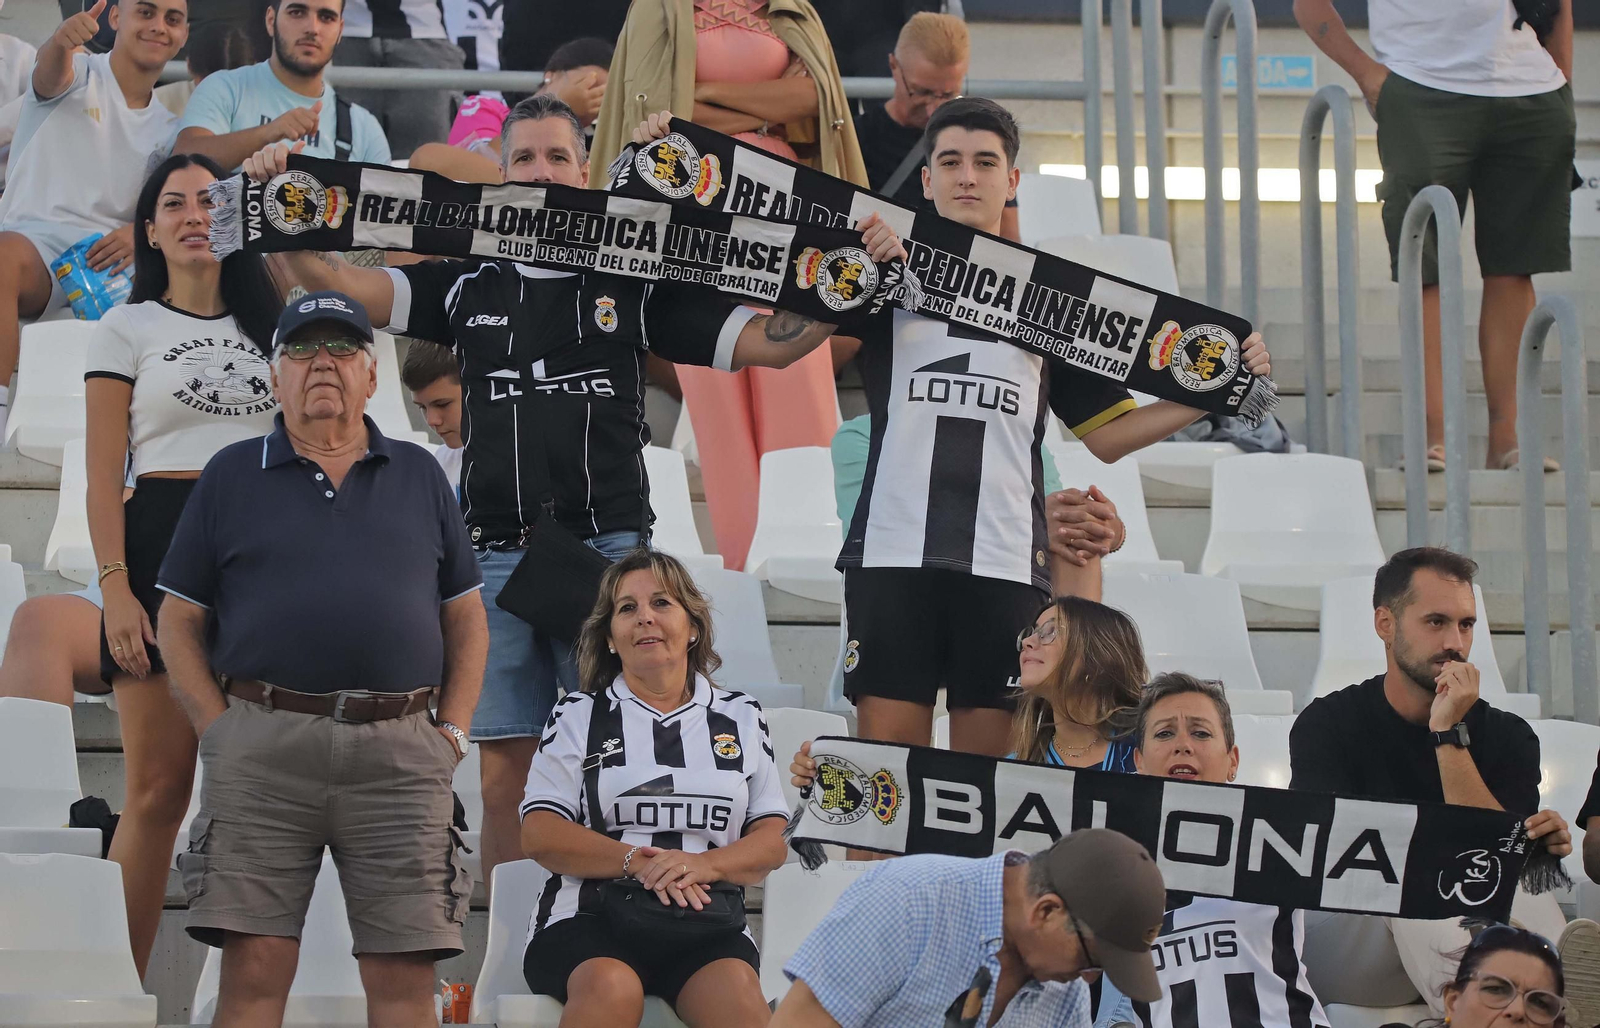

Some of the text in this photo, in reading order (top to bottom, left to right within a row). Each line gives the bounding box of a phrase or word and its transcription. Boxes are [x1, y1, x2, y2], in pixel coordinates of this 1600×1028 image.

[290, 173, 313, 185] REAL
[246, 178, 262, 241] ALONA
[359, 193, 786, 275] REAL BALOMPEDICA LINENSE
[497, 240, 780, 298] CLUB DECANO DEL CAMPO DE GIBRALTAR
[820, 250, 861, 286] BALOMPEDICA
[826, 294, 843, 309] REAL
[1016, 280, 1144, 355] LINENSE
[163, 338, 215, 362] GREAT
[955, 305, 980, 324] DEL
[983, 312, 1033, 343] CAMPO
[1032, 331, 1053, 351] DE
[1052, 339, 1130, 377] GIBRALTAR
[1173, 327, 1223, 368] BALOMPEDICA
[1180, 374, 1201, 389] REAL
[1219, 348, 1239, 382] LINENSE
[172, 389, 241, 416] NATIONAL
[908, 377, 1020, 416] LOTUS
[824, 757, 850, 768] REAL
[613, 802, 732, 832] LOTUS
[828, 774, 872, 823] BALOMPEDICA
[1150, 930, 1239, 972] OTUS
